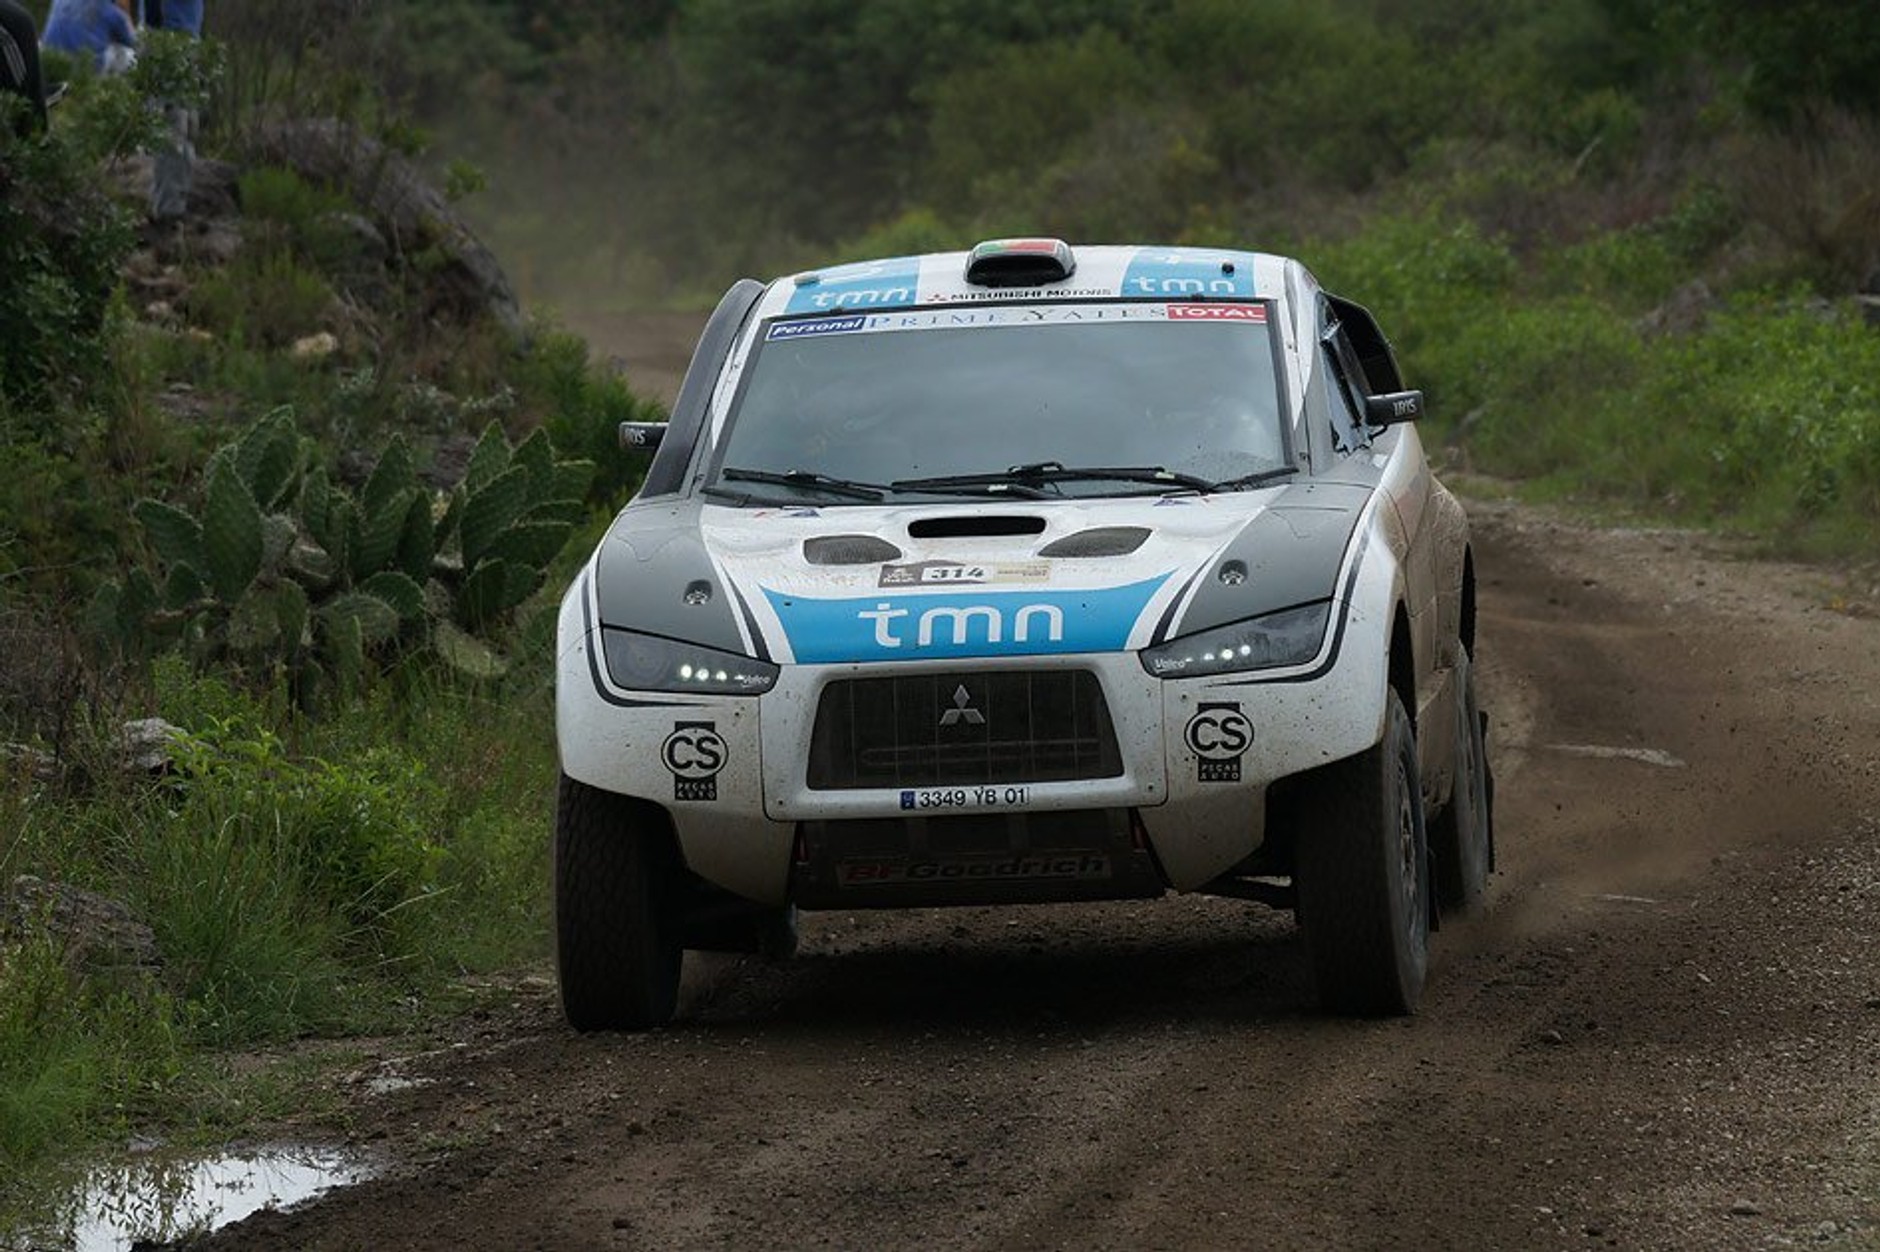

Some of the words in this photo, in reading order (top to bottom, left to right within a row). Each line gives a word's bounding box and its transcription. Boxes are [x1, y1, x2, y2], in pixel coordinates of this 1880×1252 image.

[951, 290, 1042, 300] MITSUBISHI
[1047, 288, 1111, 298] MOTORS
[1130, 276, 1235, 294] tmn
[811, 286, 909, 308] tmn
[1169, 306, 1265, 319] TOTAL
[771, 317, 864, 336] Personal
[930, 566, 985, 579] 314
[857, 602, 1064, 648] tmn
[1191, 716, 1247, 752] CS
[667, 735, 720, 770] CS
[919, 789, 967, 807] 3349
[1004, 788, 1025, 804] 01
